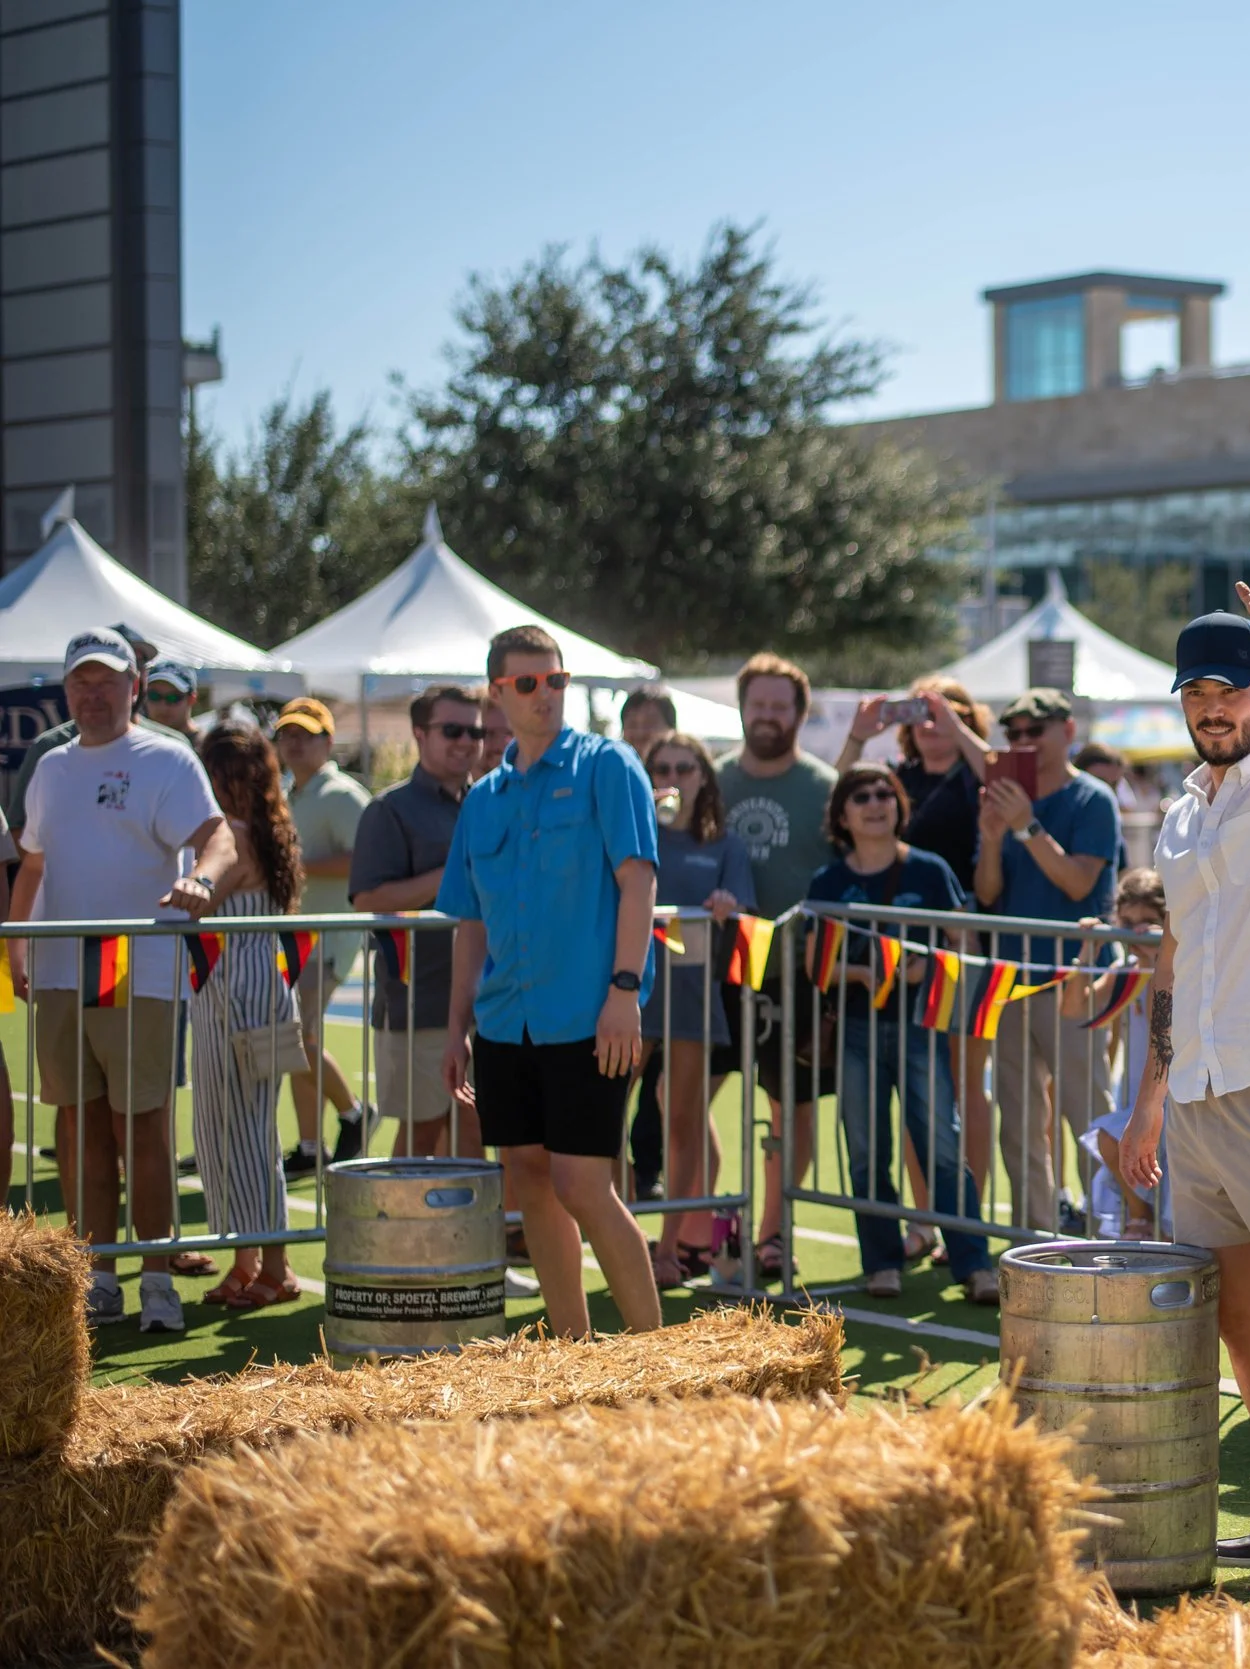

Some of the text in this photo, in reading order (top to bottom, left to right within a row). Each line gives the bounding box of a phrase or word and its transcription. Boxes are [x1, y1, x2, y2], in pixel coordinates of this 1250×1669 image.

[335, 1288, 373, 1303] PROPERTY
[393, 1292, 438, 1305] SPOETZL
[440, 1289, 481, 1304] BREWERY
